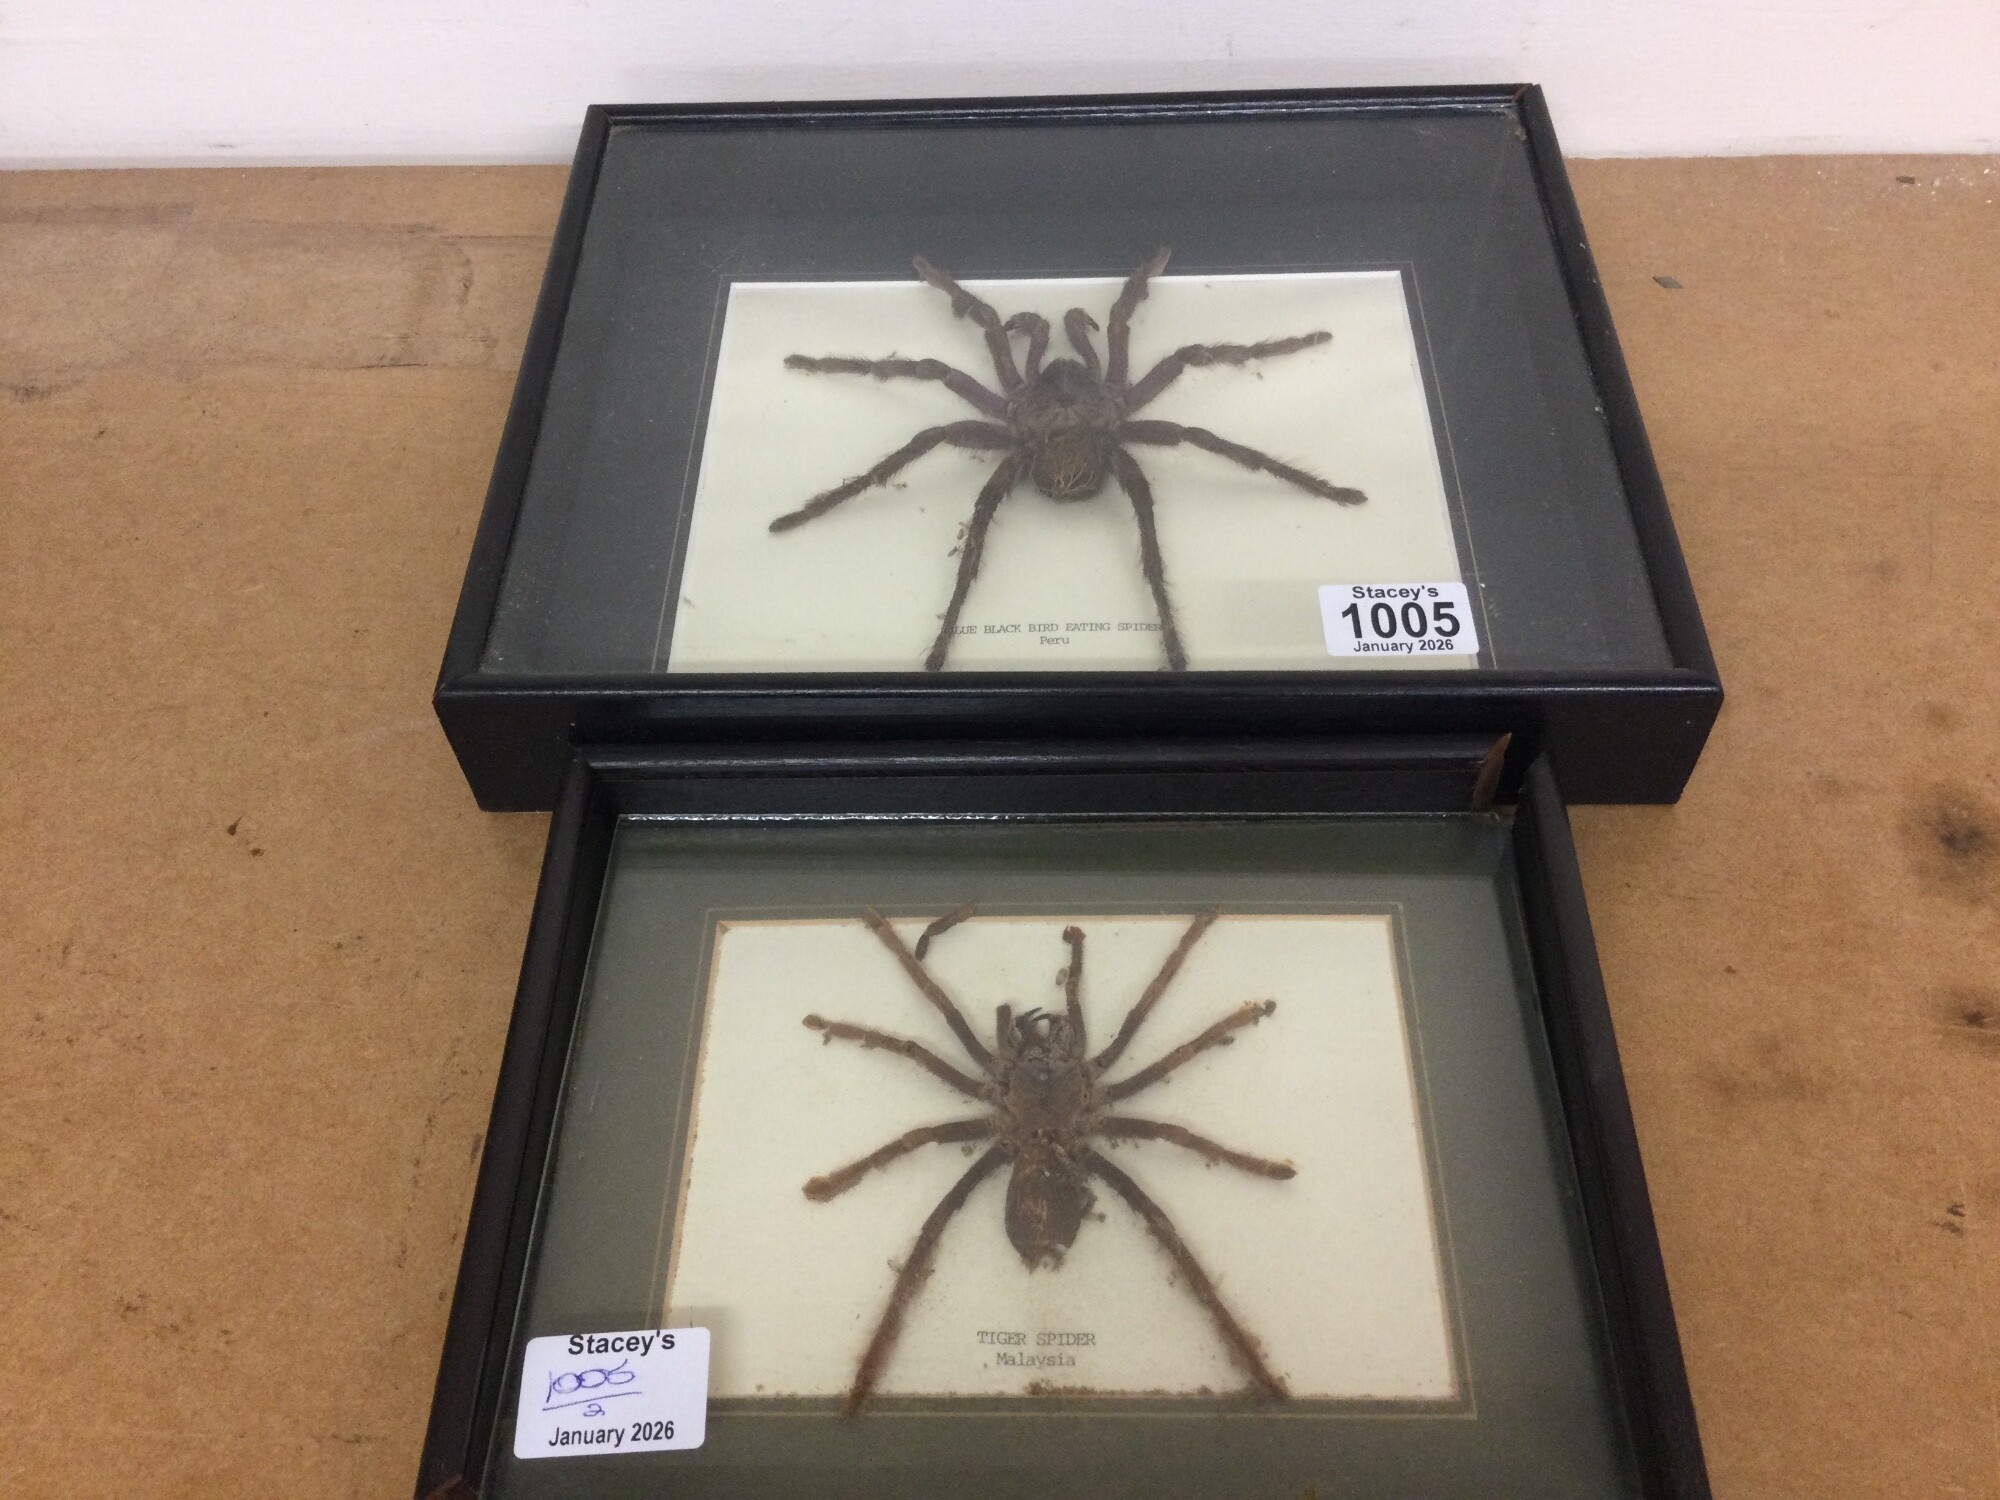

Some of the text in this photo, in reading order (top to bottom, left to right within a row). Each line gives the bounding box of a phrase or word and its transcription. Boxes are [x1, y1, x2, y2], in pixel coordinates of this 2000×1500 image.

[1352, 585, 1439, 601] Stacey's
[953, 625, 977, 634] LUE
[983, 625, 1021, 634] BLACK
[1028, 623, 1058, 633] BIRD
[1065, 622, 1111, 632] EATING
[1341, 601, 1460, 639] 1005
[1039, 636, 1070, 645] Peru
[1353, 639, 1454, 654] January 2026
[568, 1330, 675, 1356] Stacey's
[976, 1330, 1096, 1346] TIGER SPIDER
[996, 1352, 1076, 1369] Malaysia
[548, 1420, 675, 1448] January 2026
